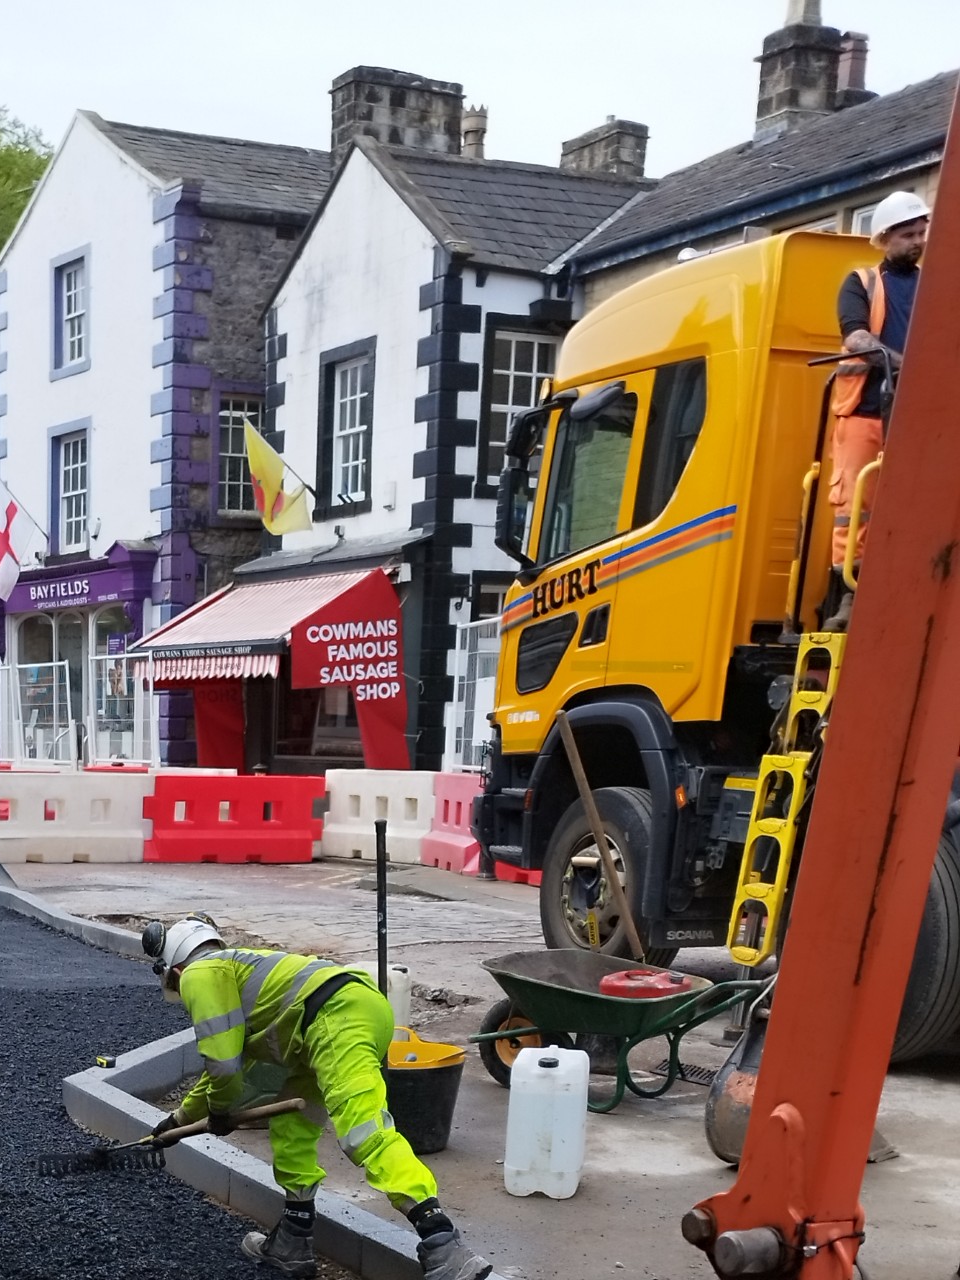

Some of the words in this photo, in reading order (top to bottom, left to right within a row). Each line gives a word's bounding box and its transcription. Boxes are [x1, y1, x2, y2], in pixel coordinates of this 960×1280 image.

[29, 580, 90, 600] BAYFIELDS
[532, 559, 601, 618] HURT
[306, 619, 398, 643] COWMANS
[153, 650, 181, 658] COWMANS
[181, 648, 205, 657] FAMOUS
[206, 647, 232, 656] SAUSAGE
[233, 645, 252, 654] SHOP
[327, 640, 398, 662] FAMOUS
[320, 661, 398, 684] SAUSAGE
[356, 681, 401, 701] SHOP
[666, 930, 715, 940] SCANIA
